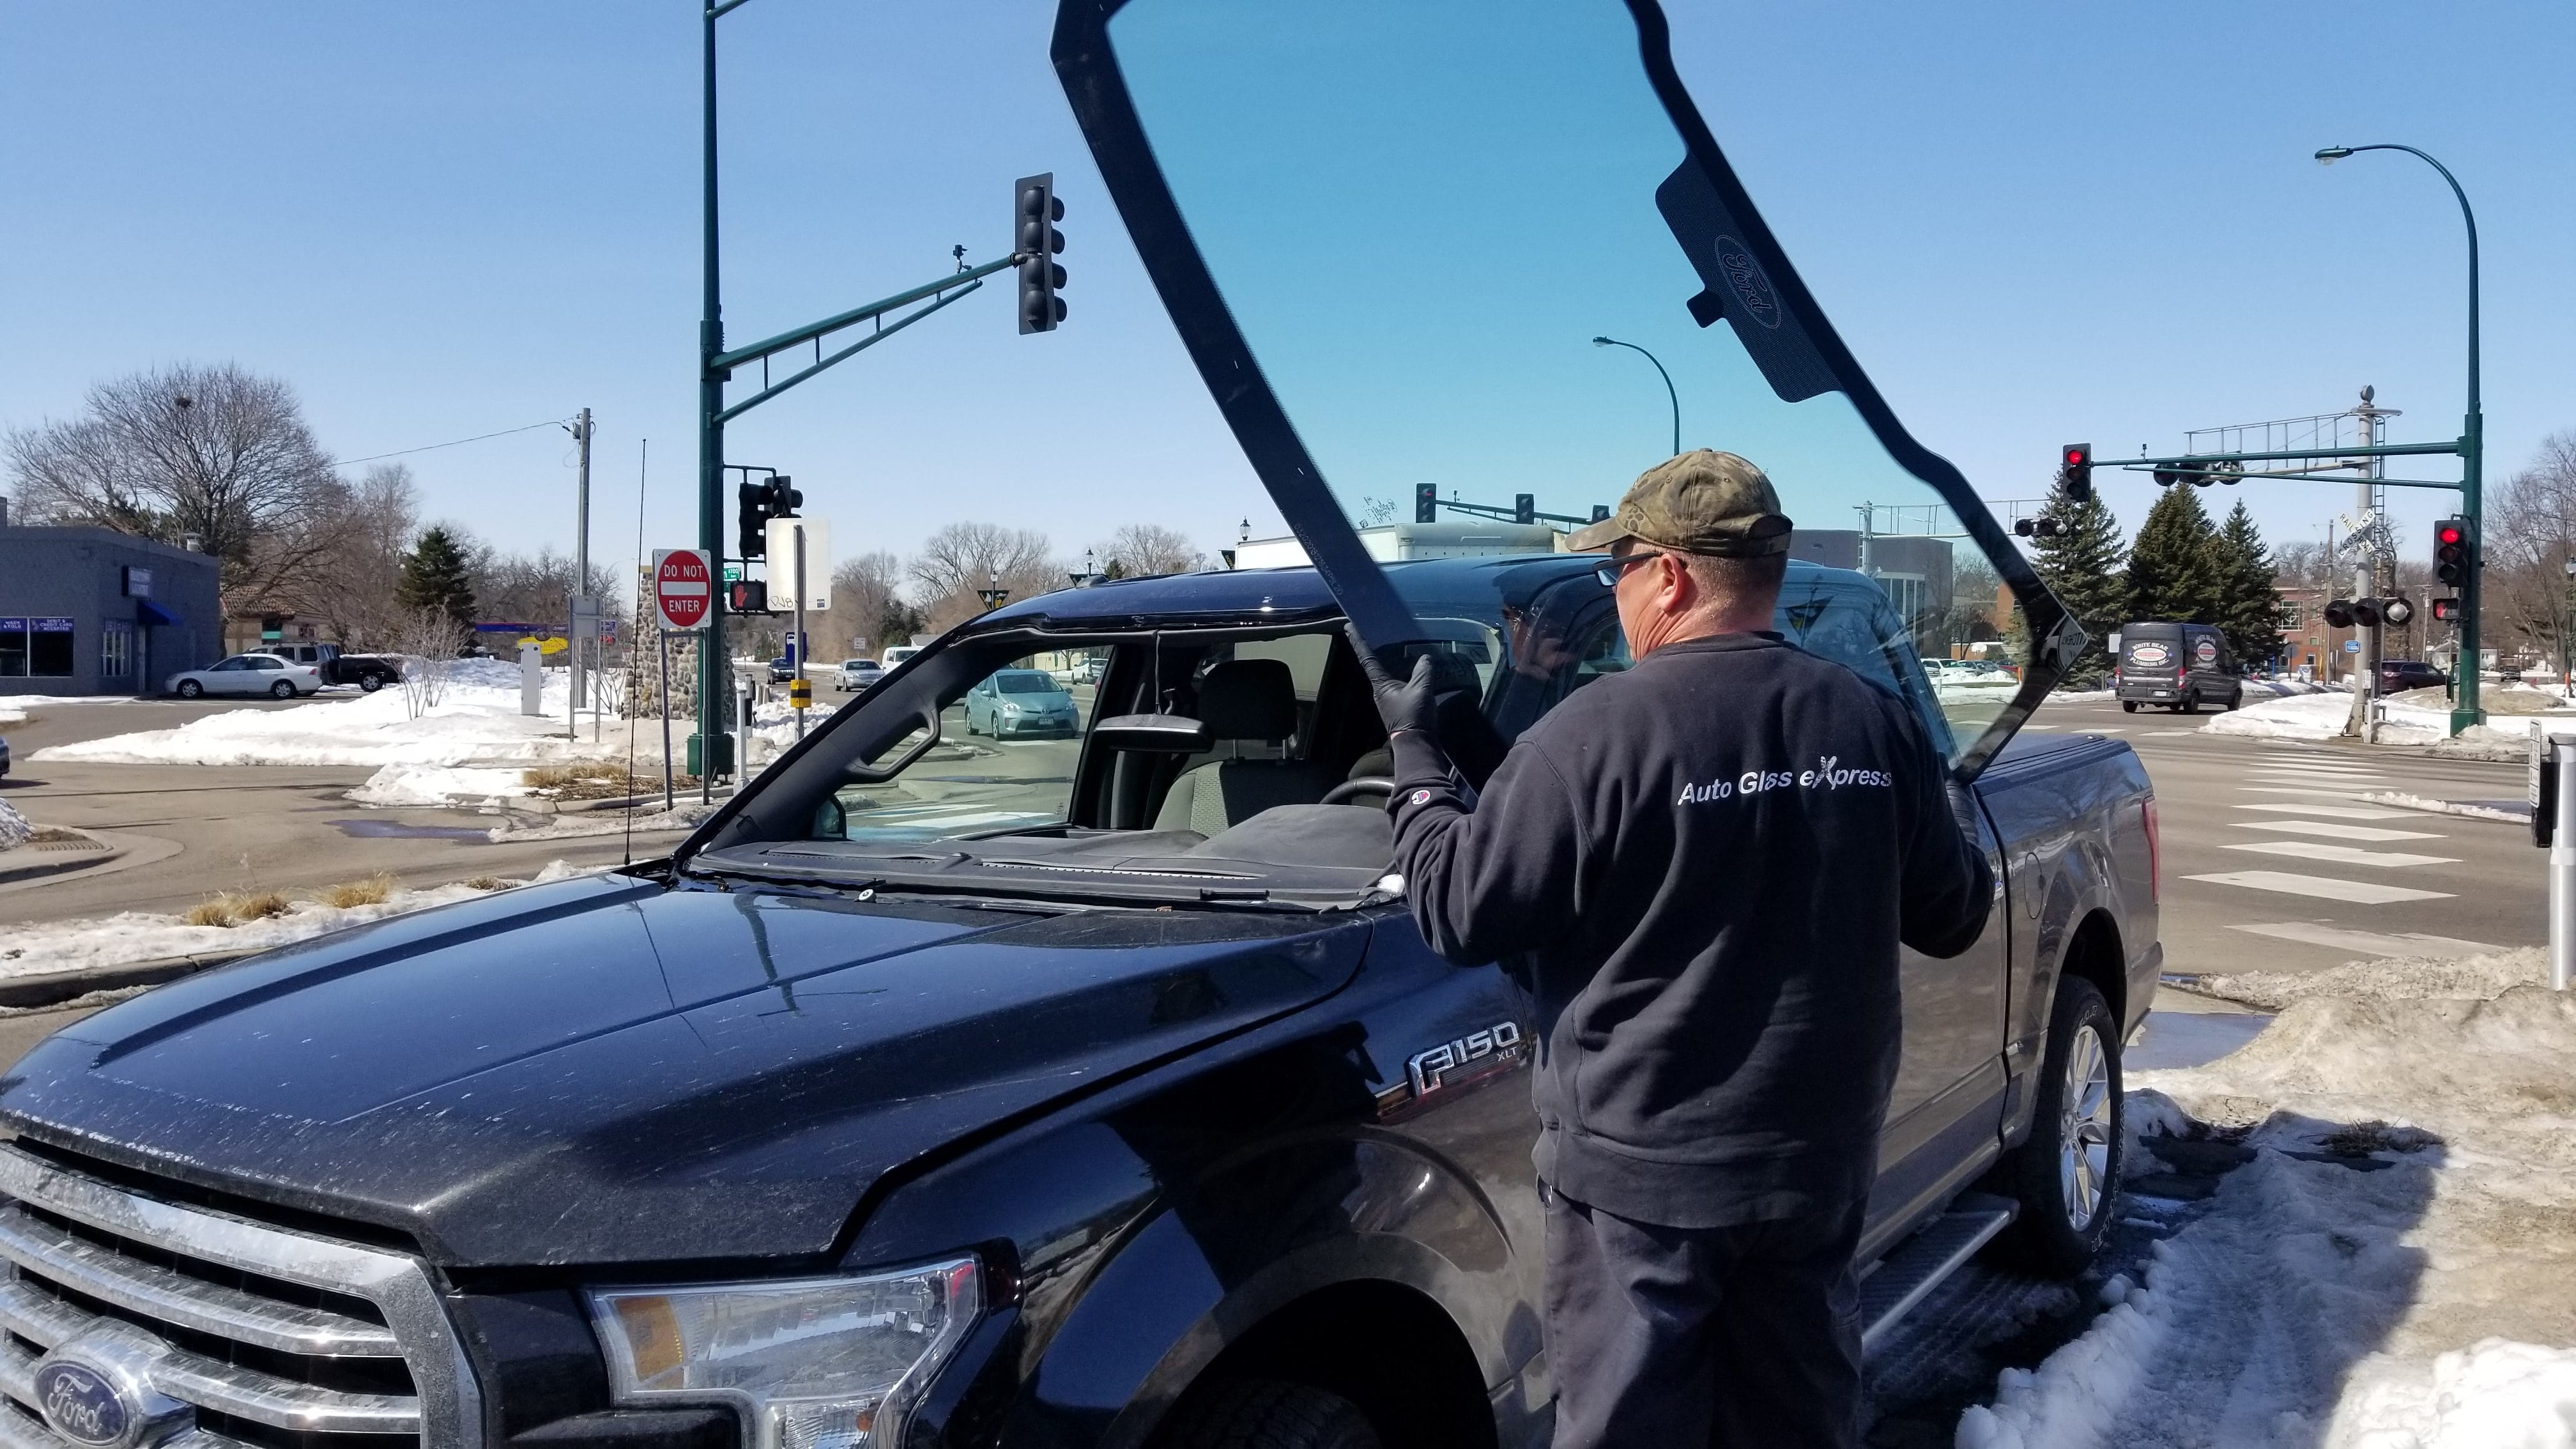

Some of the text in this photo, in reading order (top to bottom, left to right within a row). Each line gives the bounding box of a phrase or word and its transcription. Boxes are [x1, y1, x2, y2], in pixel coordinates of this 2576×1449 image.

[1722, 254, 1772, 313] Ford
[2339, 511, 2373, 556] CROSSING
[2340, 513, 2373, 555] RAIL ROAD
[664, 564, 703, 578] DO NOT
[669, 599, 700, 613] ENTER
[2132, 642, 2169, 652] WHITE BEAR
[1677, 778, 1732, 806] Auto
[1497, 1046, 1517, 1062] XLT
[47, 1372, 105, 1436] Ford
